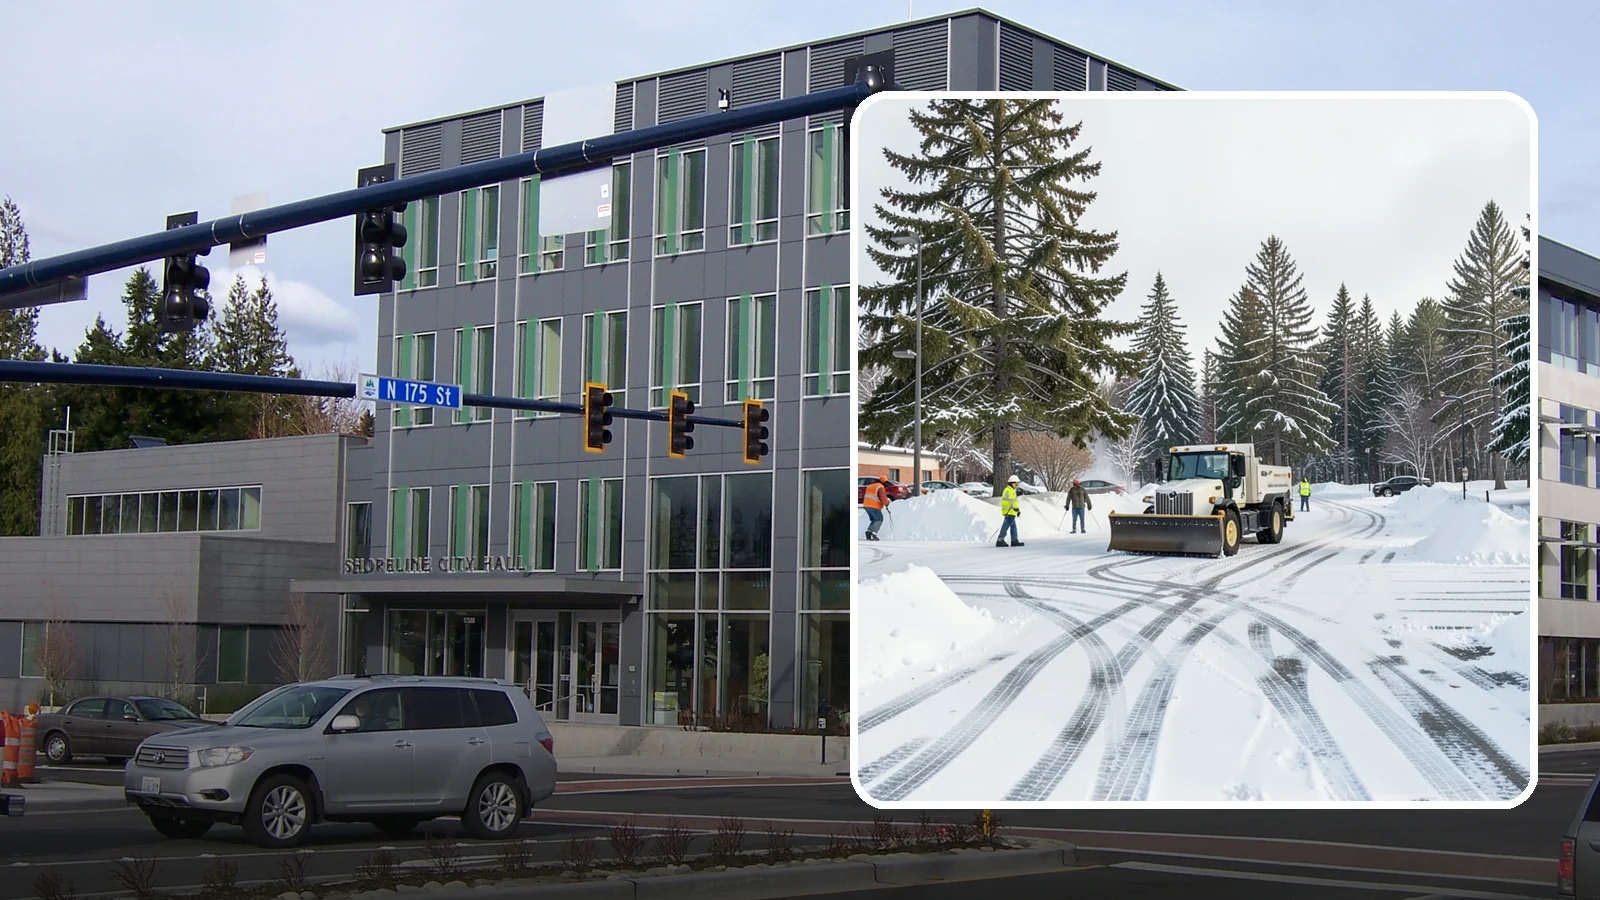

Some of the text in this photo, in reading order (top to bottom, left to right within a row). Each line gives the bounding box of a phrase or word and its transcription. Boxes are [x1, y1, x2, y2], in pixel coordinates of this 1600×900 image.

[387, 380, 452, 406] N 175 St
[344, 554, 526, 574] SHORELINE CITY HALL
